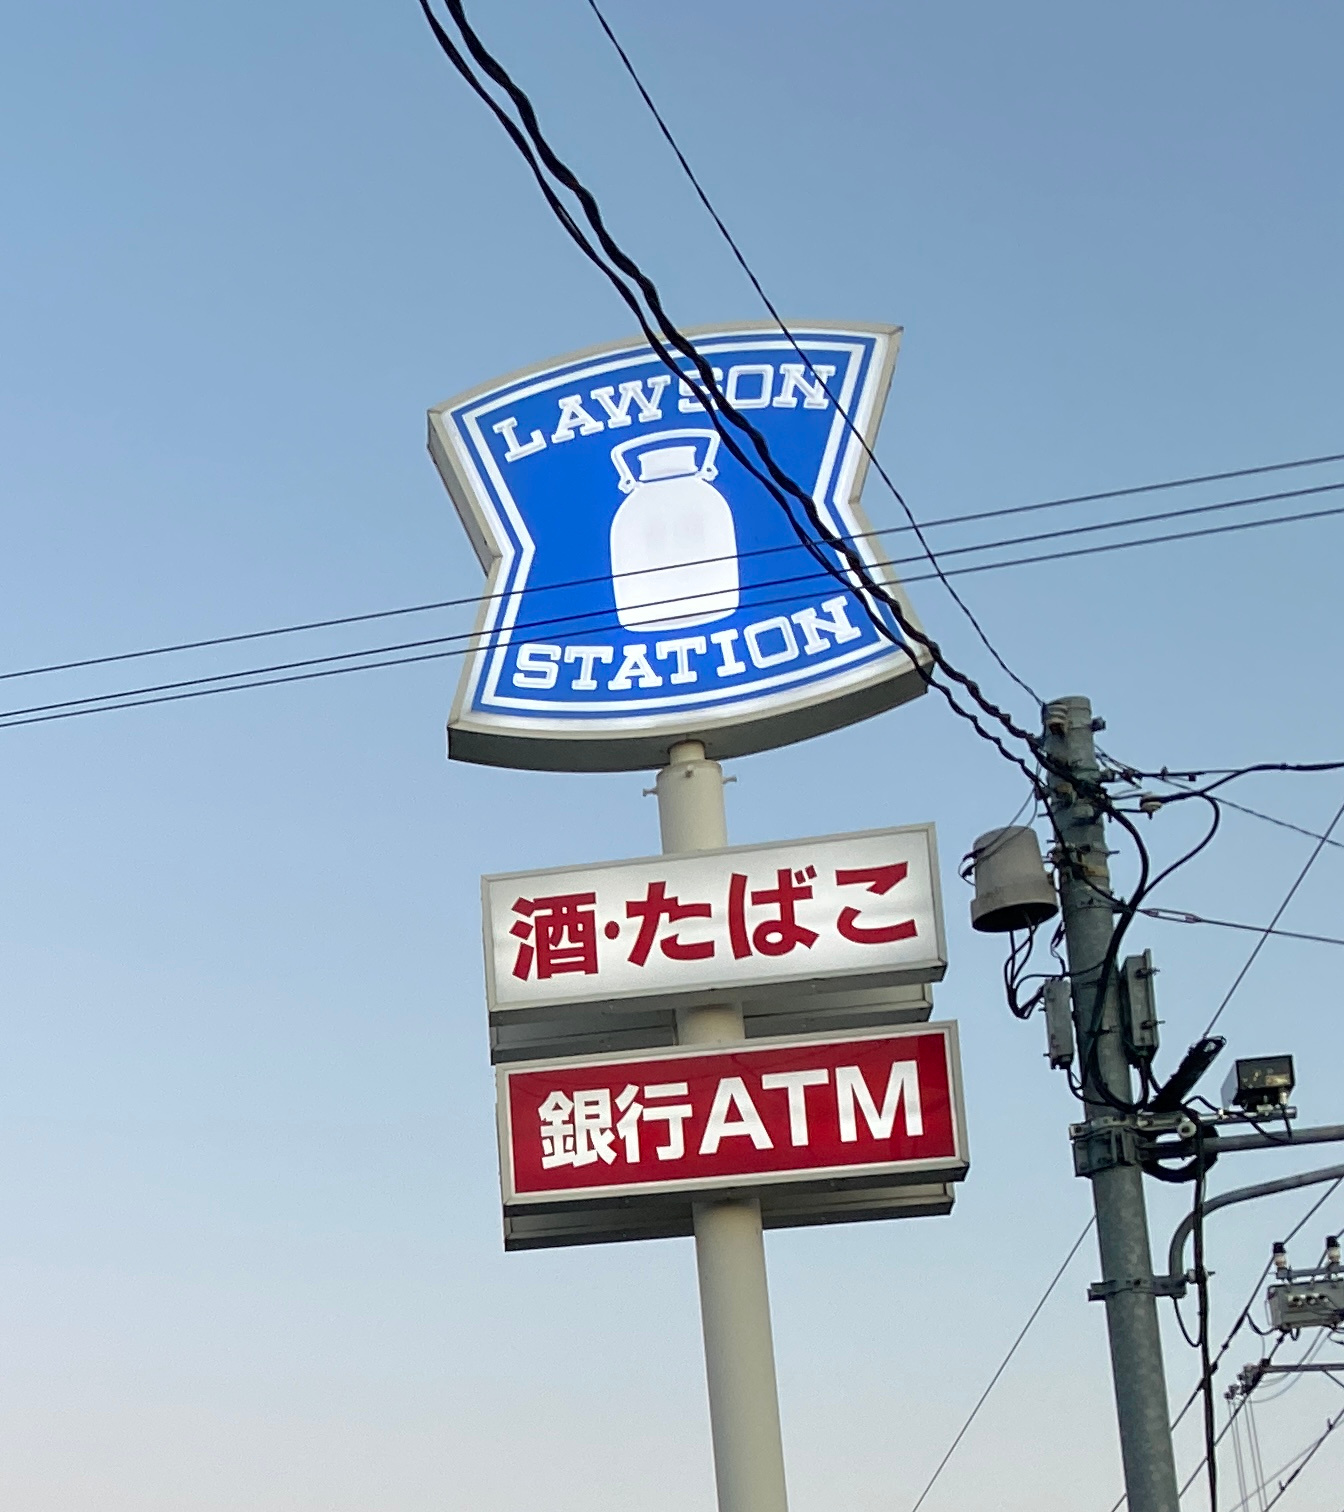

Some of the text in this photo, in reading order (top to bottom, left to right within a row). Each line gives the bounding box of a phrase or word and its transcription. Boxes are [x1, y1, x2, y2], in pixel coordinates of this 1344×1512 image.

[492, 363, 836, 463] LAWSON
[512, 595, 863, 690] STATION
[509, 860, 918, 982] 酒・たばこ
[537, 1059, 925, 1170] 銀行ATM
